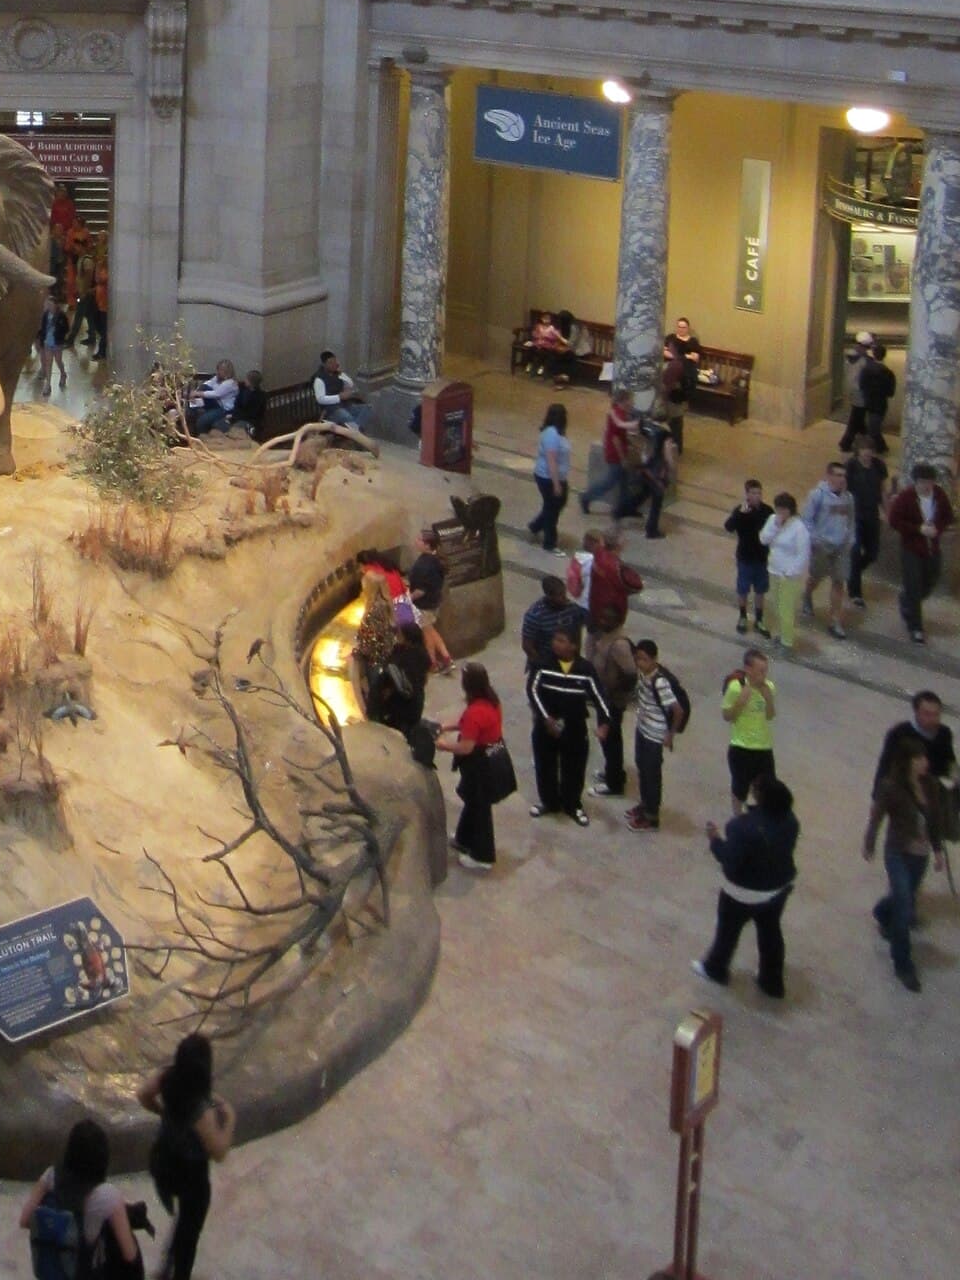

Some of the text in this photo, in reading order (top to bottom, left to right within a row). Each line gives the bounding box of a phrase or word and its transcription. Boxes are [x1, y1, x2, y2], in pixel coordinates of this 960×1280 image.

[534, 114, 610, 136] Ancient Seas
[65, 143, 112, 152] AUDITORIUM
[533, 130, 577, 152] Ice Age
[72, 165, 94, 174] SHOP
[30, 930, 58, 948] TRAIL
